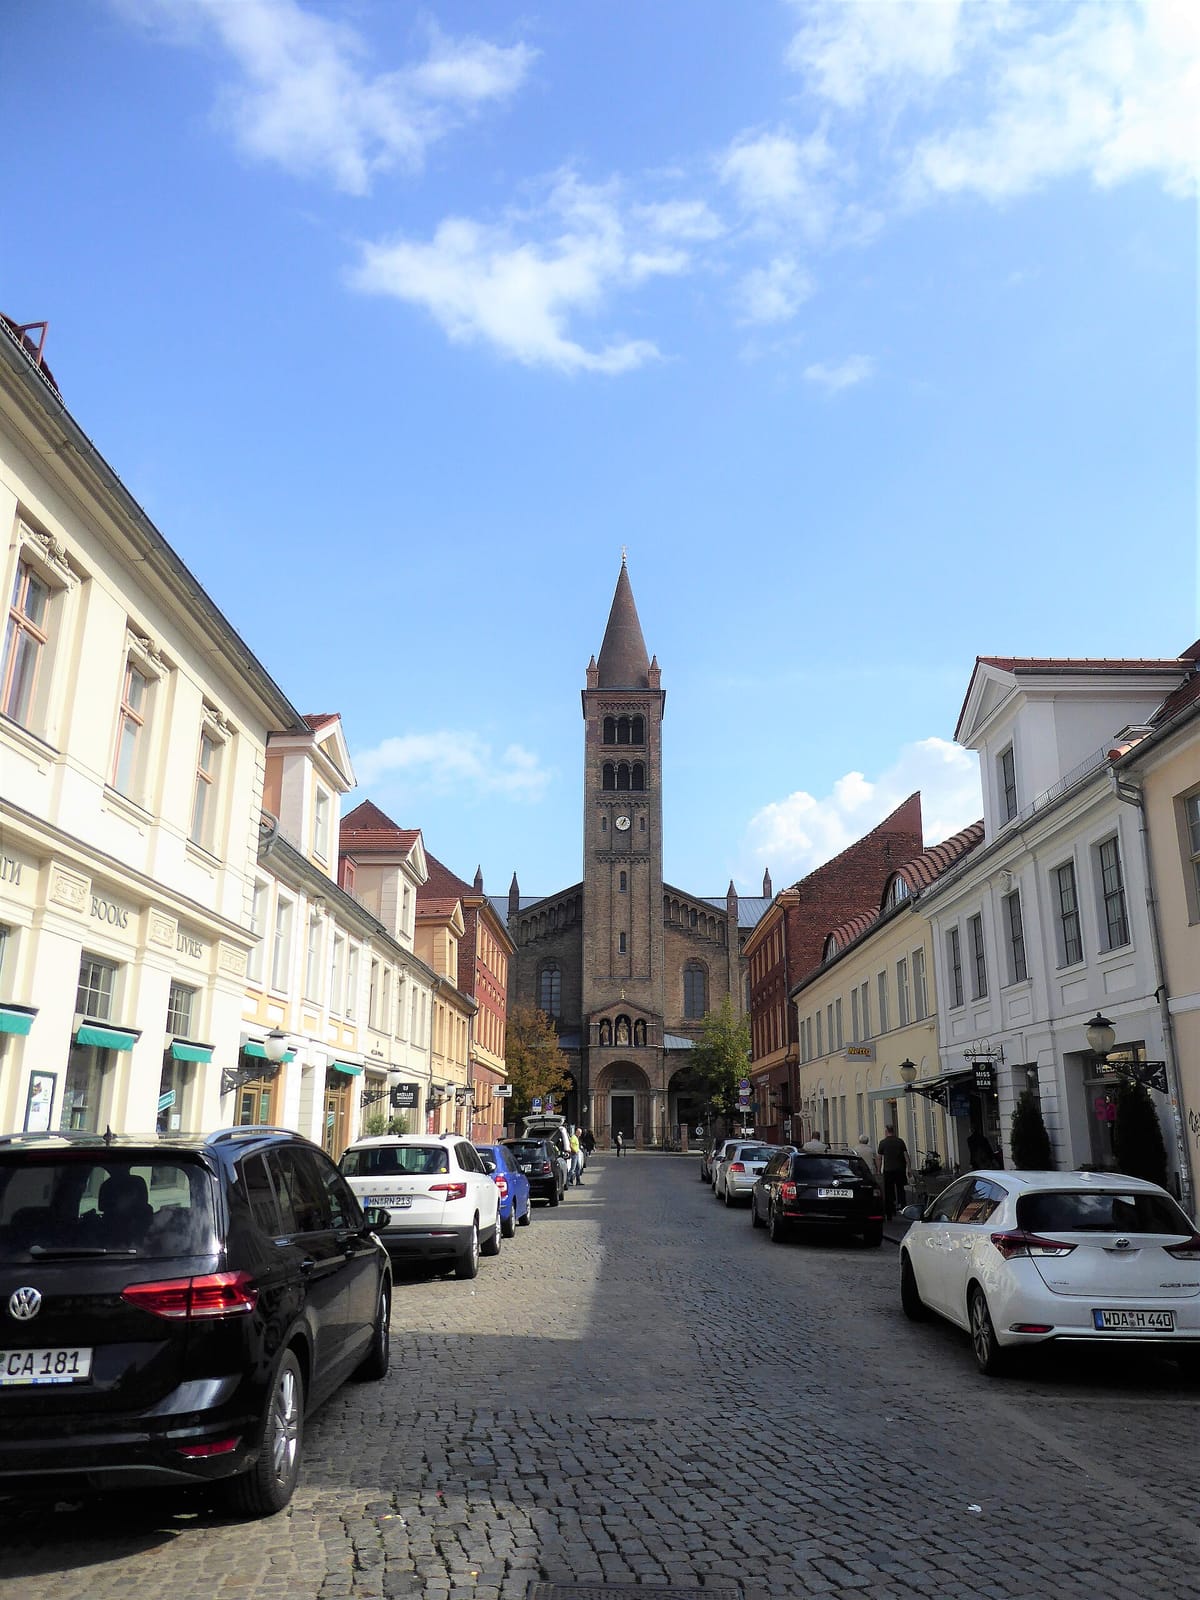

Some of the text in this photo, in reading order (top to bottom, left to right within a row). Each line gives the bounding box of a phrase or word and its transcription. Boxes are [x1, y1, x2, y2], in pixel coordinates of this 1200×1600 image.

[0, 856, 21, 886] ГИ
[90, 896, 128, 929] BOOKS
[176, 934, 202, 959] LIVRES
[848, 1047, 871, 1057] Netto
[1103, 1312, 1171, 1327] WDA H 440
[7, 1351, 79, 1376] CA 181
